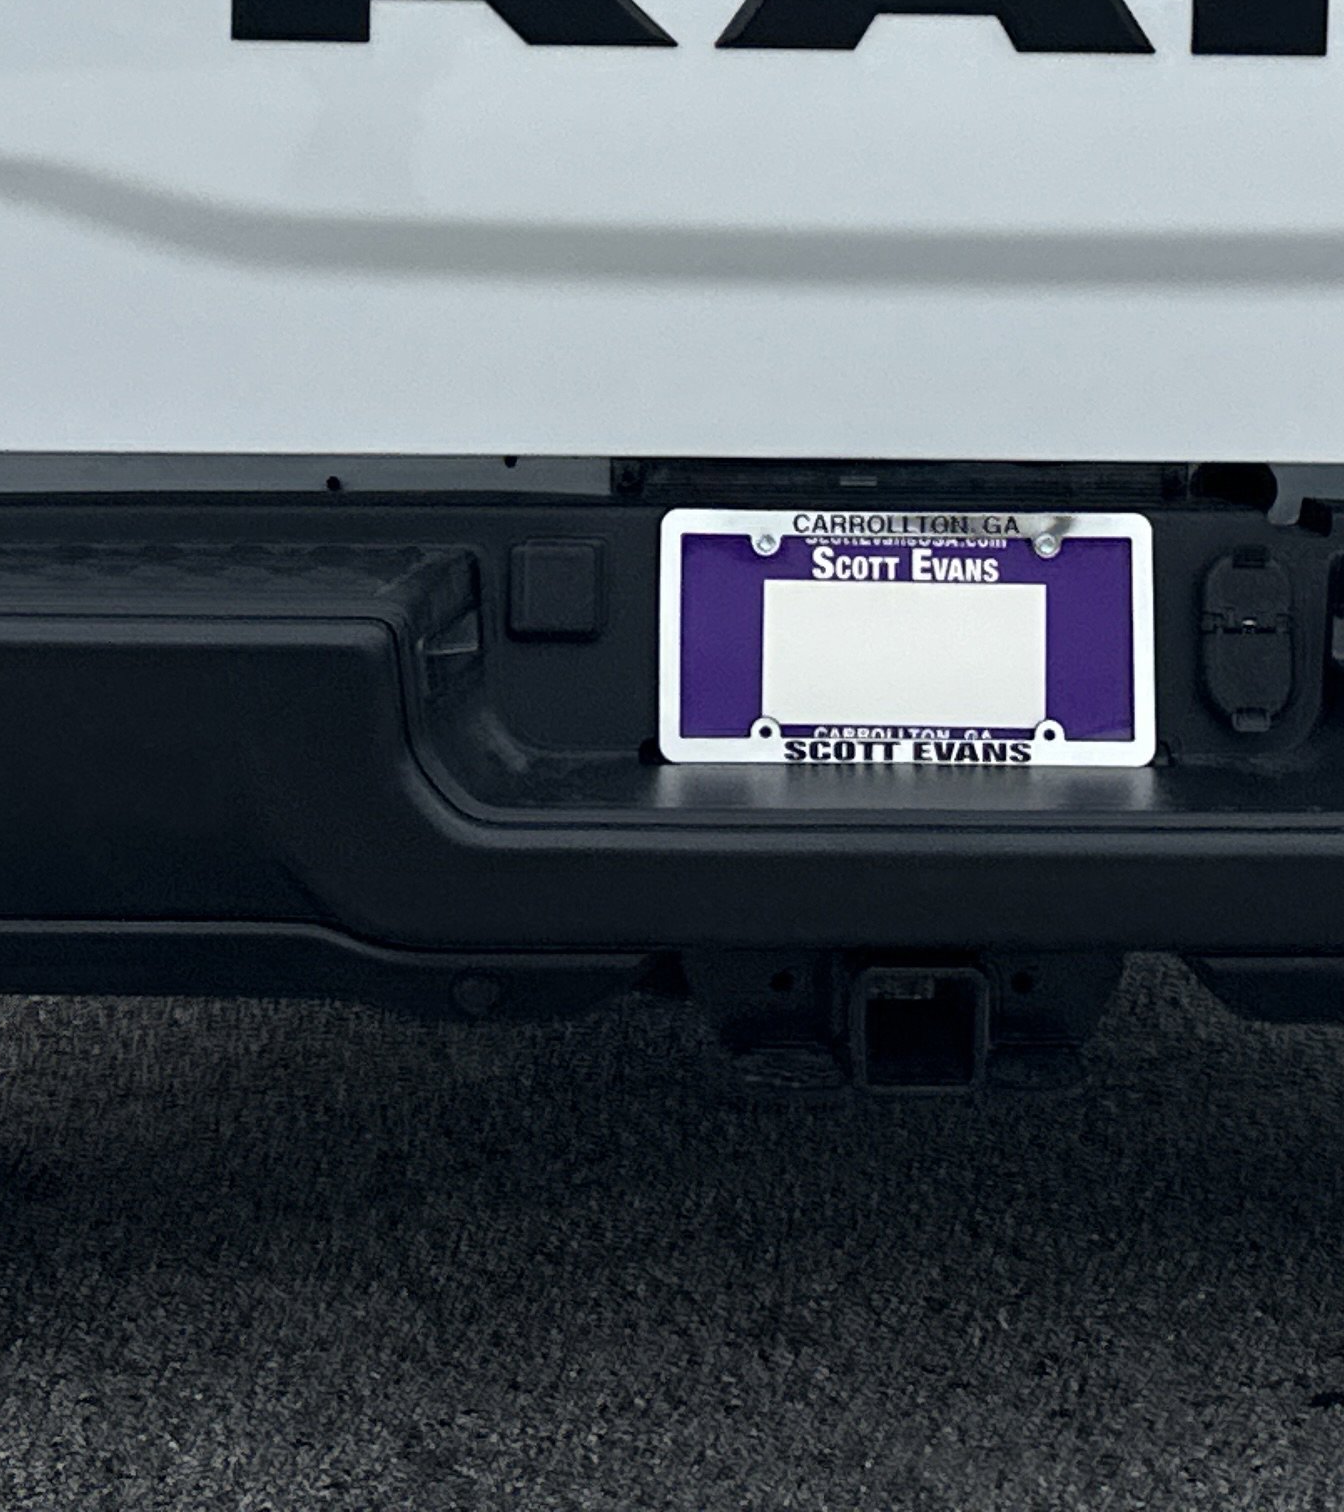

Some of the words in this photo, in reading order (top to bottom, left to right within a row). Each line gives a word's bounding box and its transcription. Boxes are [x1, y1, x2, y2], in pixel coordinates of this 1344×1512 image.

[983, 515, 1020, 534] GA
[812, 546, 899, 580] SCOTT
[912, 549, 999, 582] EVANS
[784, 740, 901, 761] SCOTT
[912, 742, 1032, 762] EVANS
